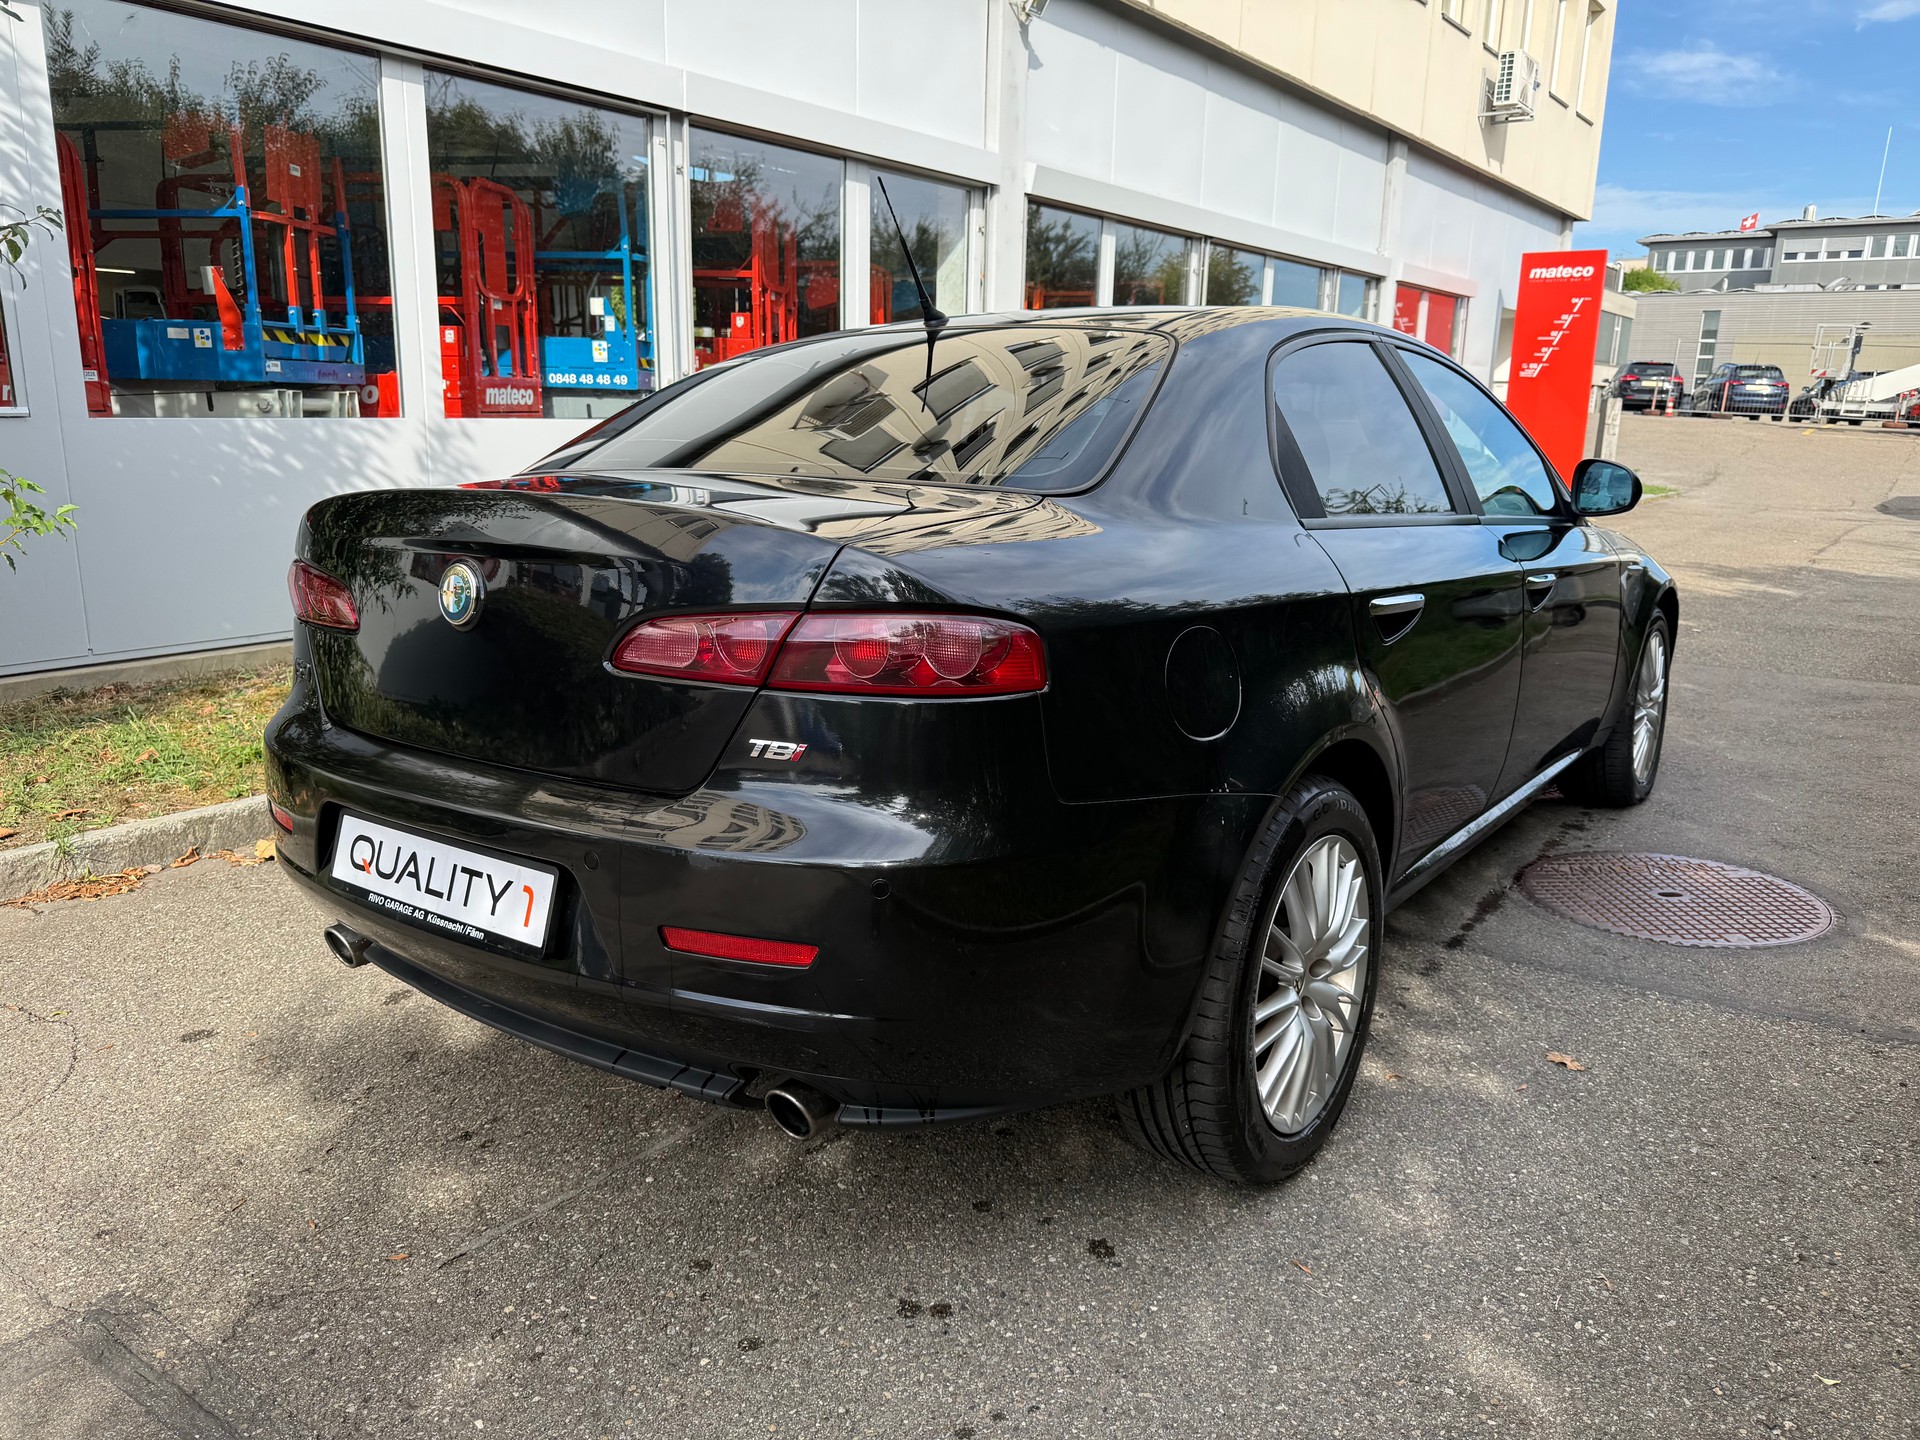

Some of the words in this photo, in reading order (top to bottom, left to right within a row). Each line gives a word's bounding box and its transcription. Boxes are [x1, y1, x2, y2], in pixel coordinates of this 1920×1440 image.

[1529, 265, 1594, 279] mateco
[549, 373, 577, 384] 0848
[579, 374, 594, 385] 48
[596, 375, 611, 385] 48
[613, 375, 628, 385] 49
[485, 385, 534, 405] mateco
[350, 834, 514, 916] QUALITY
[522, 884, 535, 928] 1
[368, 892, 385, 906] RIVO
[384, 899, 414, 916] GARAGE
[413, 909, 425, 920] AG
